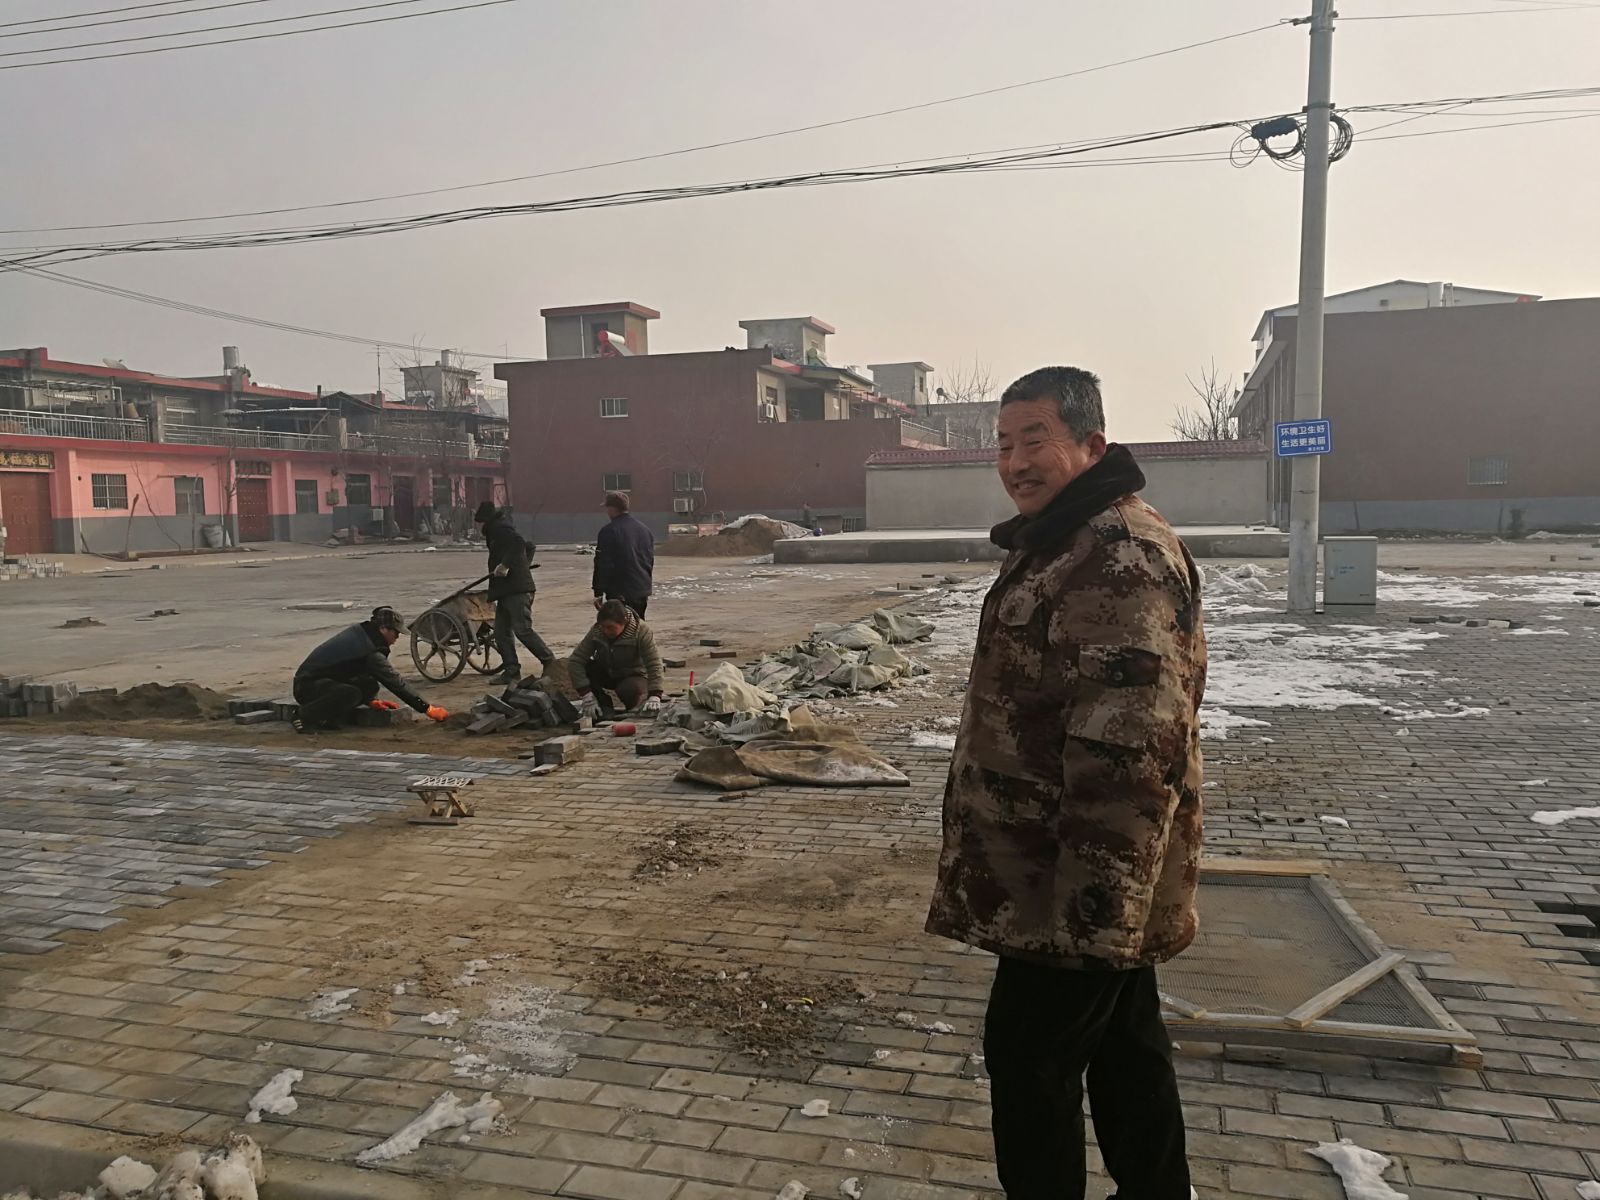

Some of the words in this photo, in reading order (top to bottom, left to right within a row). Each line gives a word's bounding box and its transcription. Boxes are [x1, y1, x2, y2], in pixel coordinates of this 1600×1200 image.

[1281, 425, 1325, 436] 环境卫生好
[1281, 437, 1326, 448] 生活更美丽
